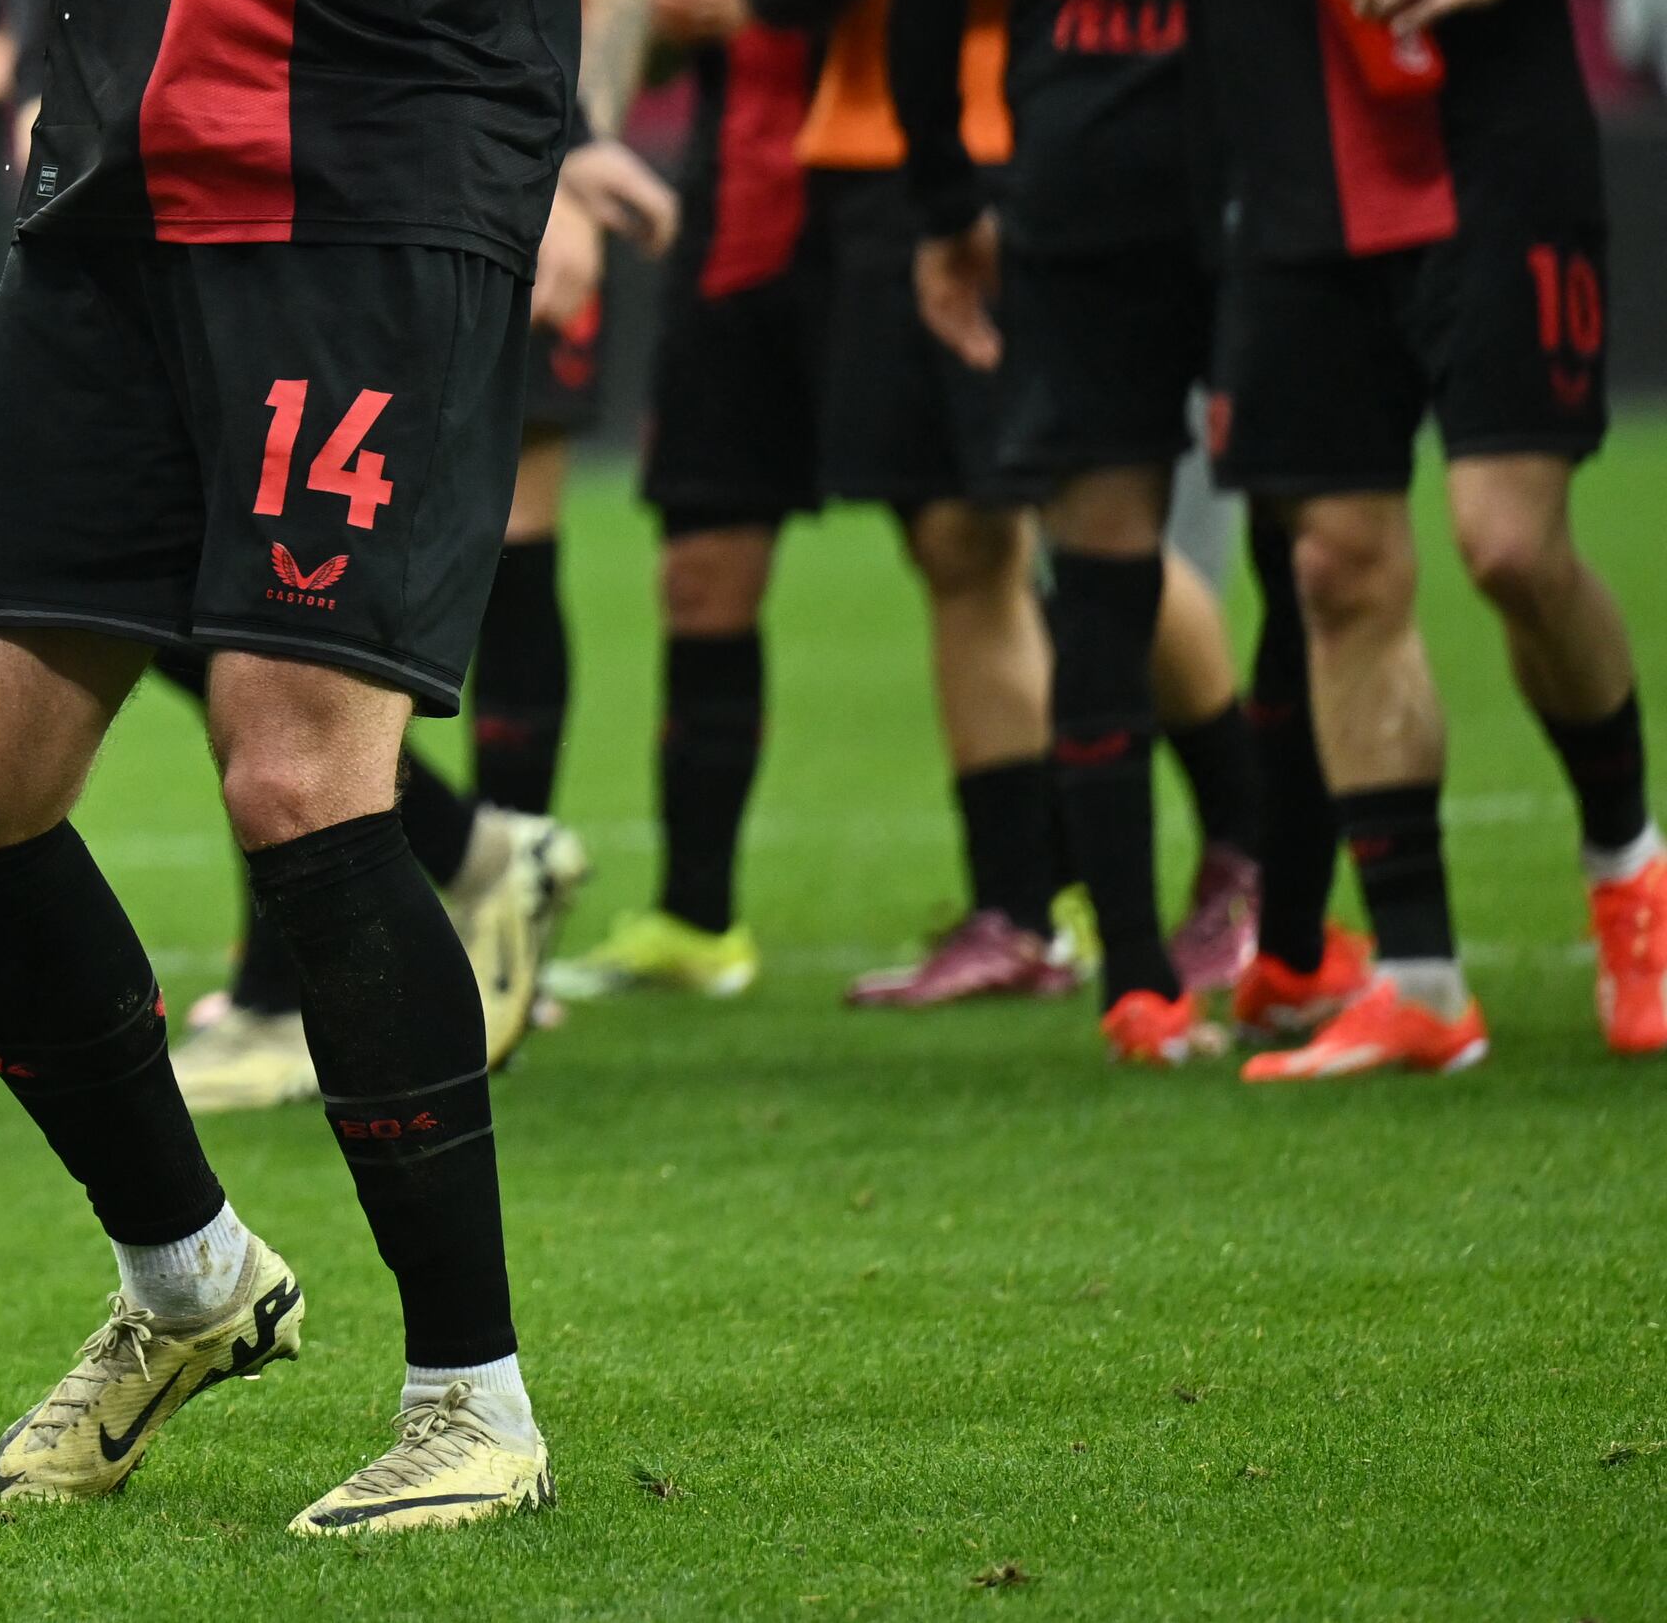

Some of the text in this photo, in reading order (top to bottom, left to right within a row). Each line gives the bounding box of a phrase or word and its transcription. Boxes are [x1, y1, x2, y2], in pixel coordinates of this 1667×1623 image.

[1526, 244, 1602, 355] 10
[252, 379, 394, 530] 14
[267, 589, 336, 610] CASTORE
